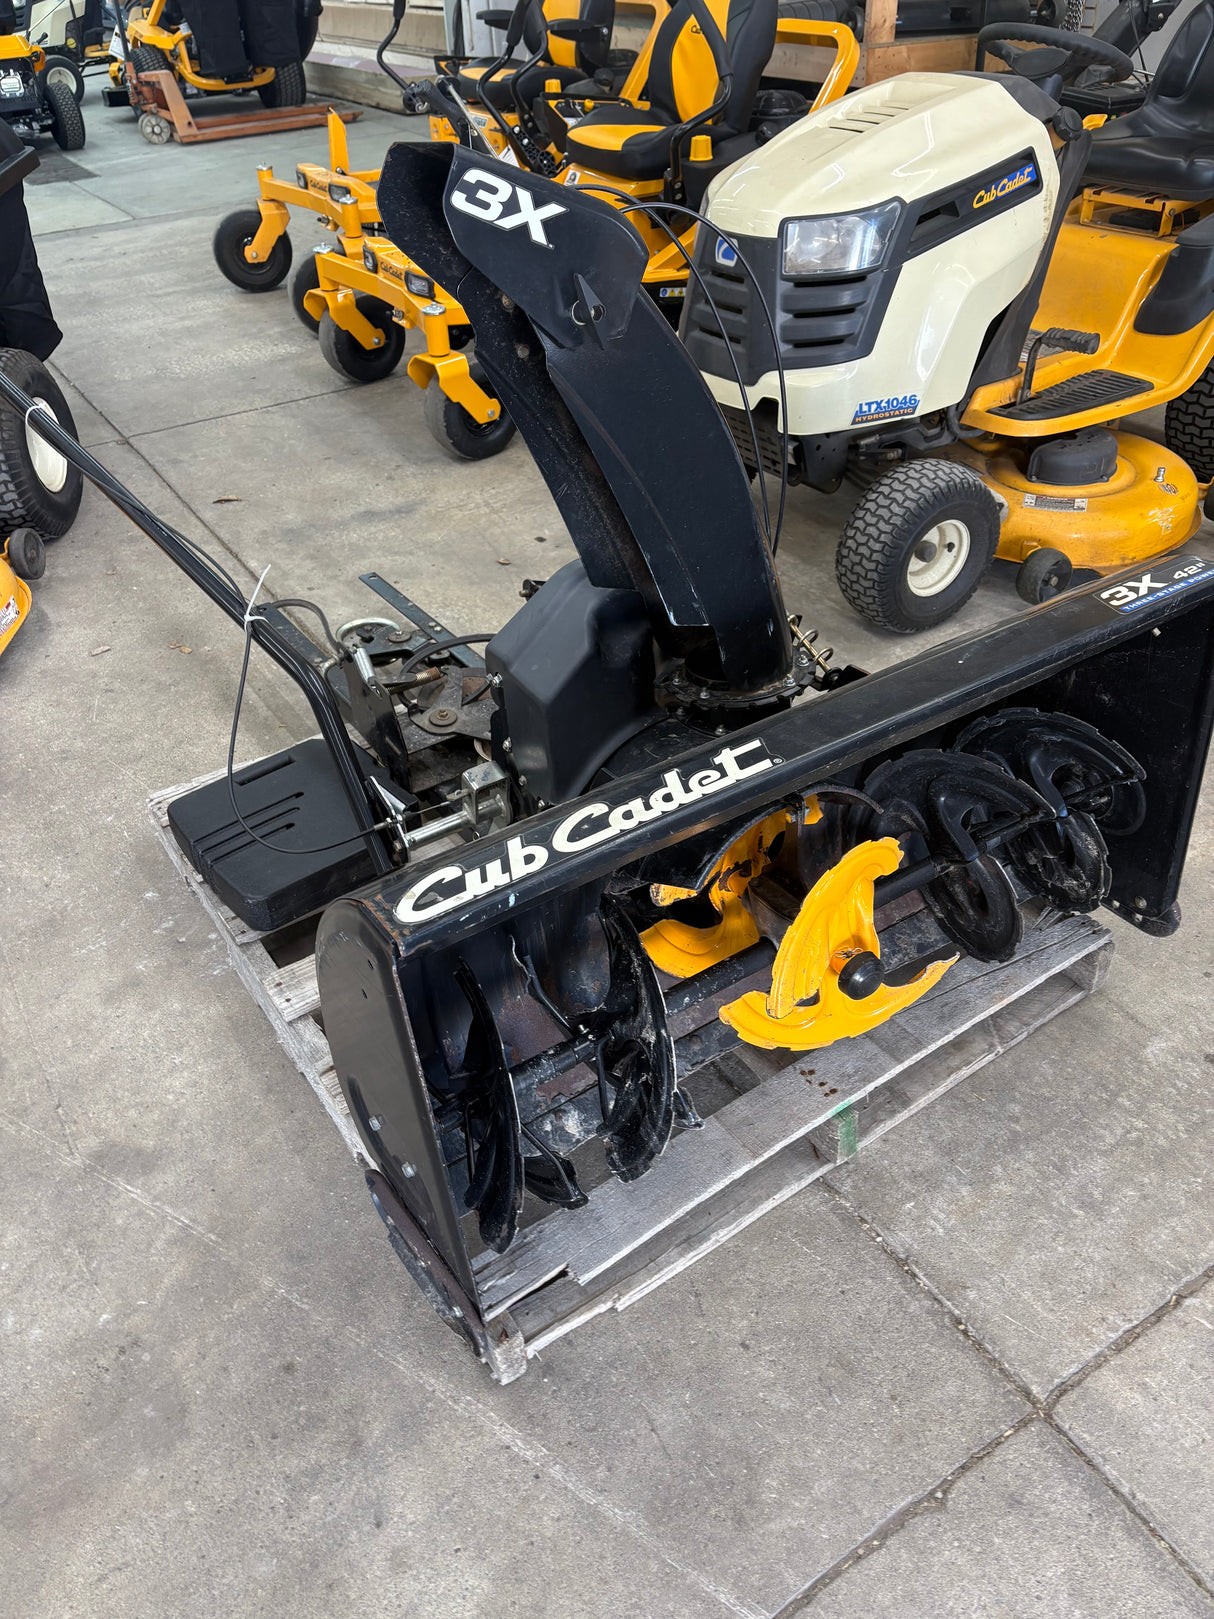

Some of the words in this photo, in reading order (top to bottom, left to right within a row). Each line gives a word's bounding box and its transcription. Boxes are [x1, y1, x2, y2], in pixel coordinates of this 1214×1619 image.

[451, 168, 568, 246] 3X
[973, 185, 997, 209] Cub
[996, 167, 1033, 197] Cadet
[855, 408, 913, 422] HYDROSTATIC
[858, 394, 918, 415] LTX1046
[1100, 573, 1170, 606] 3X
[1173, 562, 1206, 580] 42"
[1123, 582, 1188, 610] THREE-STAGE
[1187, 569, 1214, 584] POWE
[393, 838, 550, 923] Cub
[552, 739, 775, 853] Cadet
